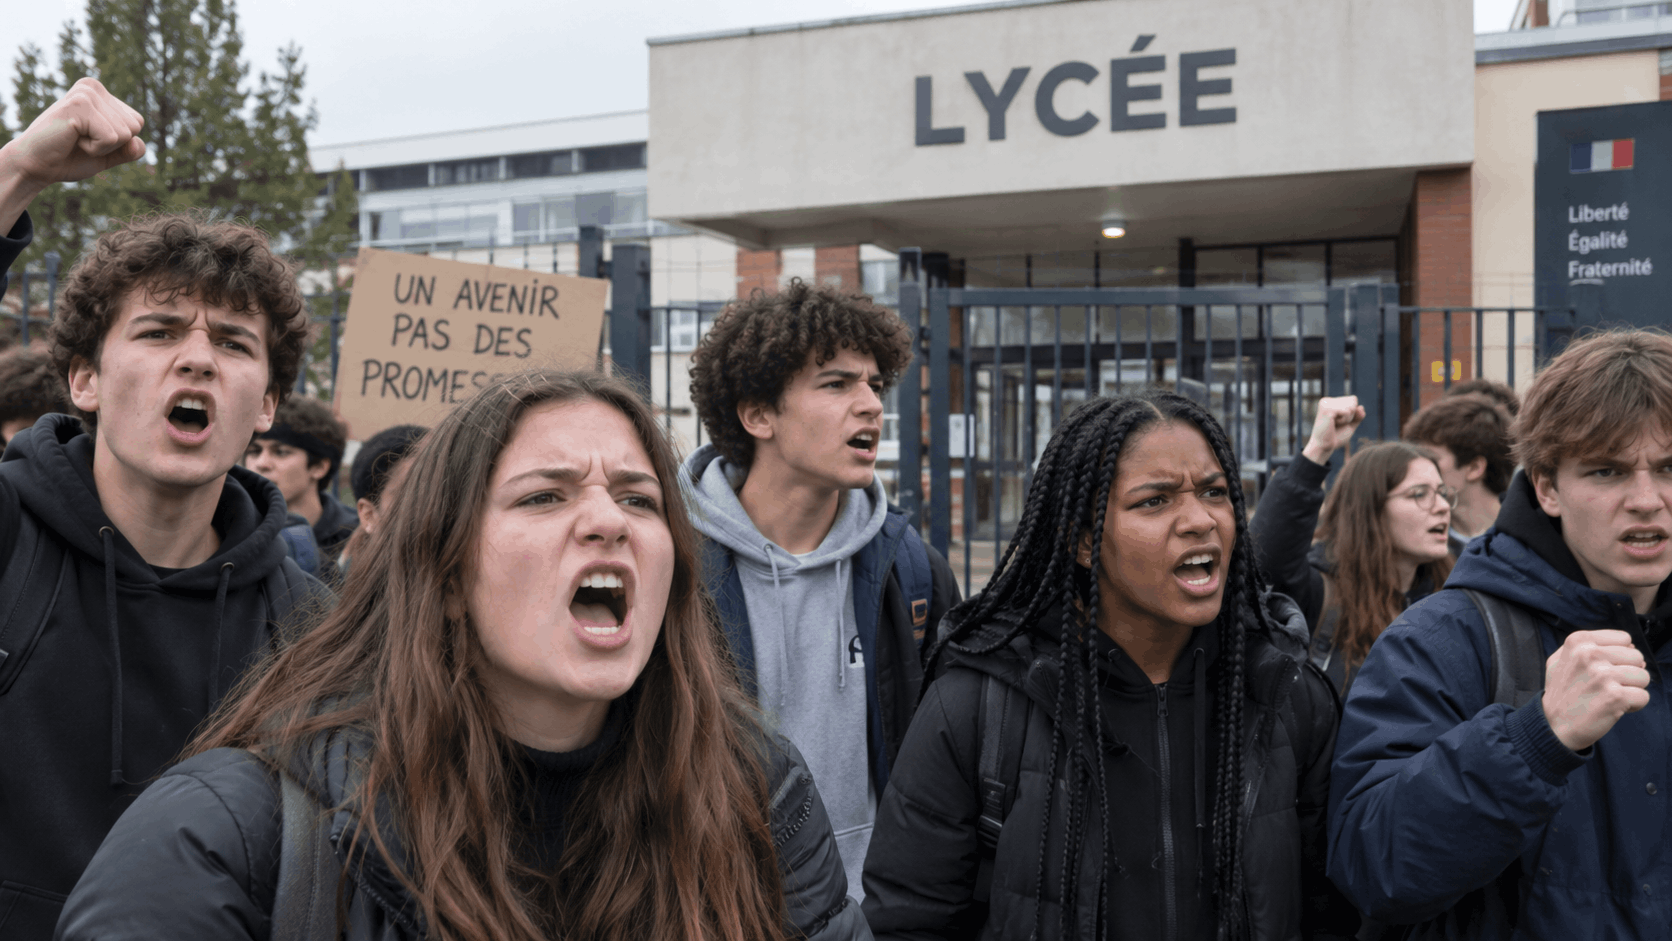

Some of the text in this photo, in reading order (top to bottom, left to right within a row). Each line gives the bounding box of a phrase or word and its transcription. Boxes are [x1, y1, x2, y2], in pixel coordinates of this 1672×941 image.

[914, 34, 1237, 147] LYCÉE
[1568, 201, 1630, 223] Liberté
[1568, 228, 1628, 255] Égalité
[1568, 257, 1653, 279] Fraternité
[394, 273, 560, 320] UN AVENIR
[391, 313, 533, 359] PAS DES
